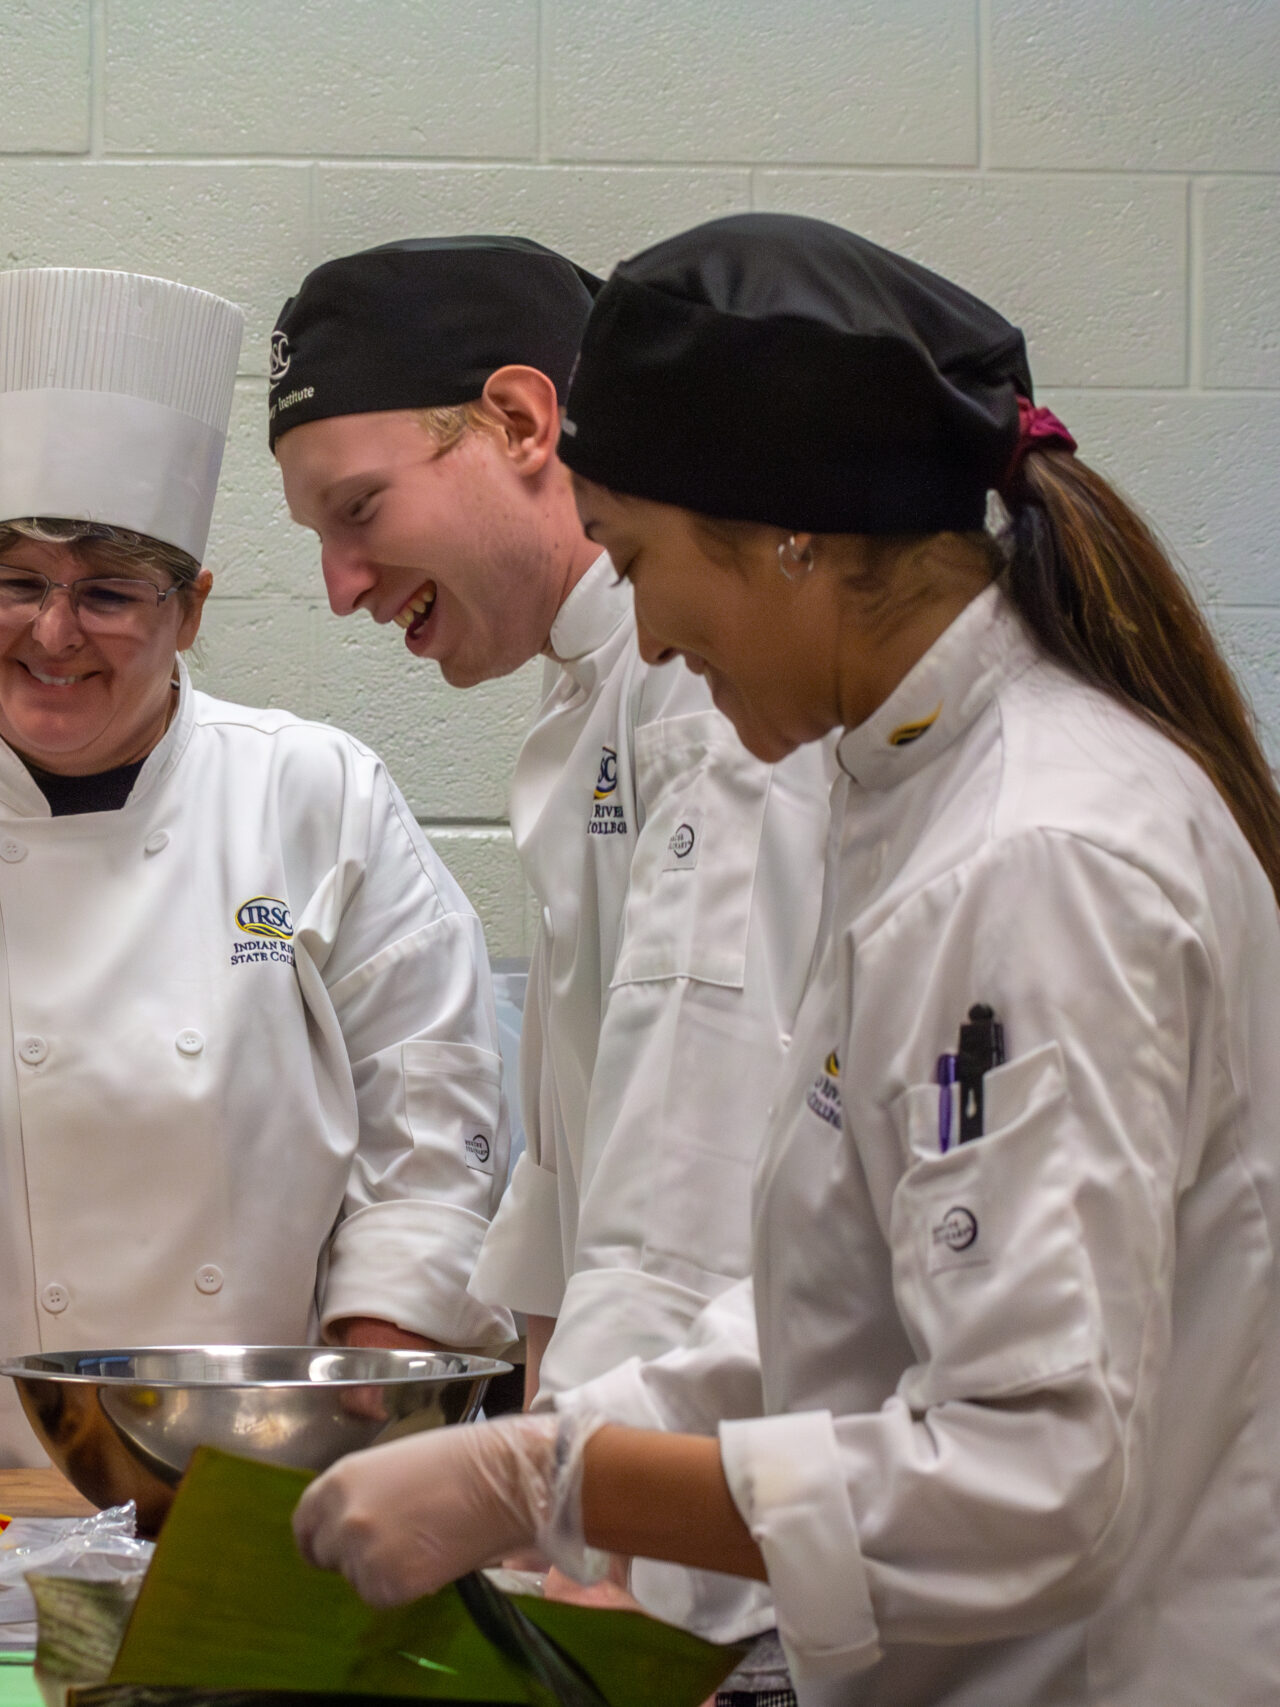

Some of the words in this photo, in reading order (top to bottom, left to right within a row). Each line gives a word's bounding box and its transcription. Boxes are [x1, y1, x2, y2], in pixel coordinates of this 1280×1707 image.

[278, 386, 315, 411] Institute
[245, 905, 293, 930] IRSC
[233, 941, 277, 954] INDIAN
[231, 952, 268, 966] STATE
